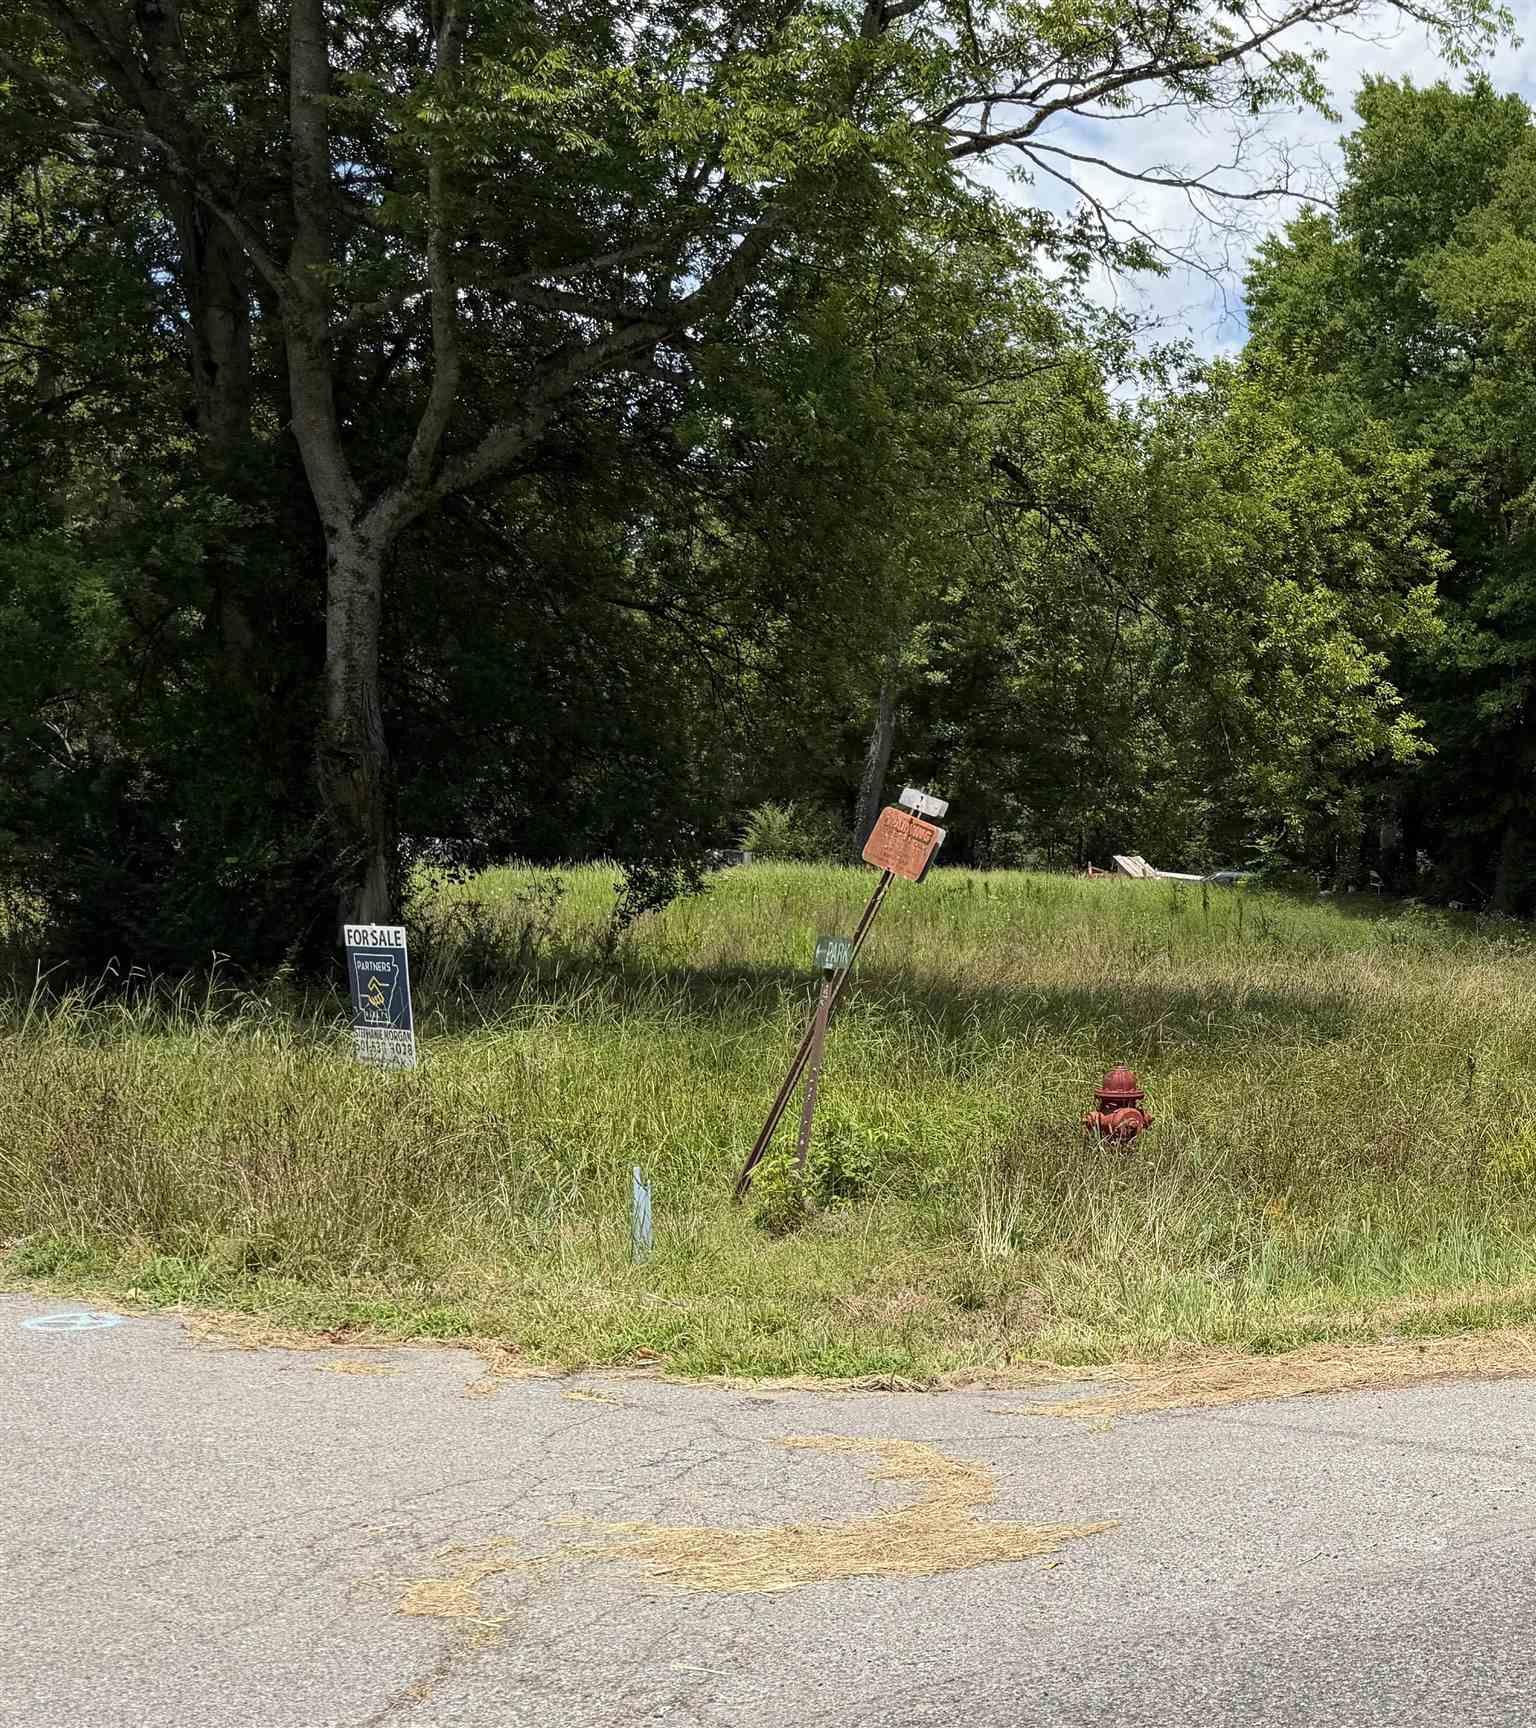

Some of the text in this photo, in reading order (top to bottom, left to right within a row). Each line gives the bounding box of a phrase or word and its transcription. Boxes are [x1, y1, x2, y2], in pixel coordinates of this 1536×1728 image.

[347, 929, 401, 946] FOR SALE
[825, 941, 852, 964] PARK
[357, 960, 391, 972] PARTNERS
[385, 1030, 412, 1041] MORGAN
